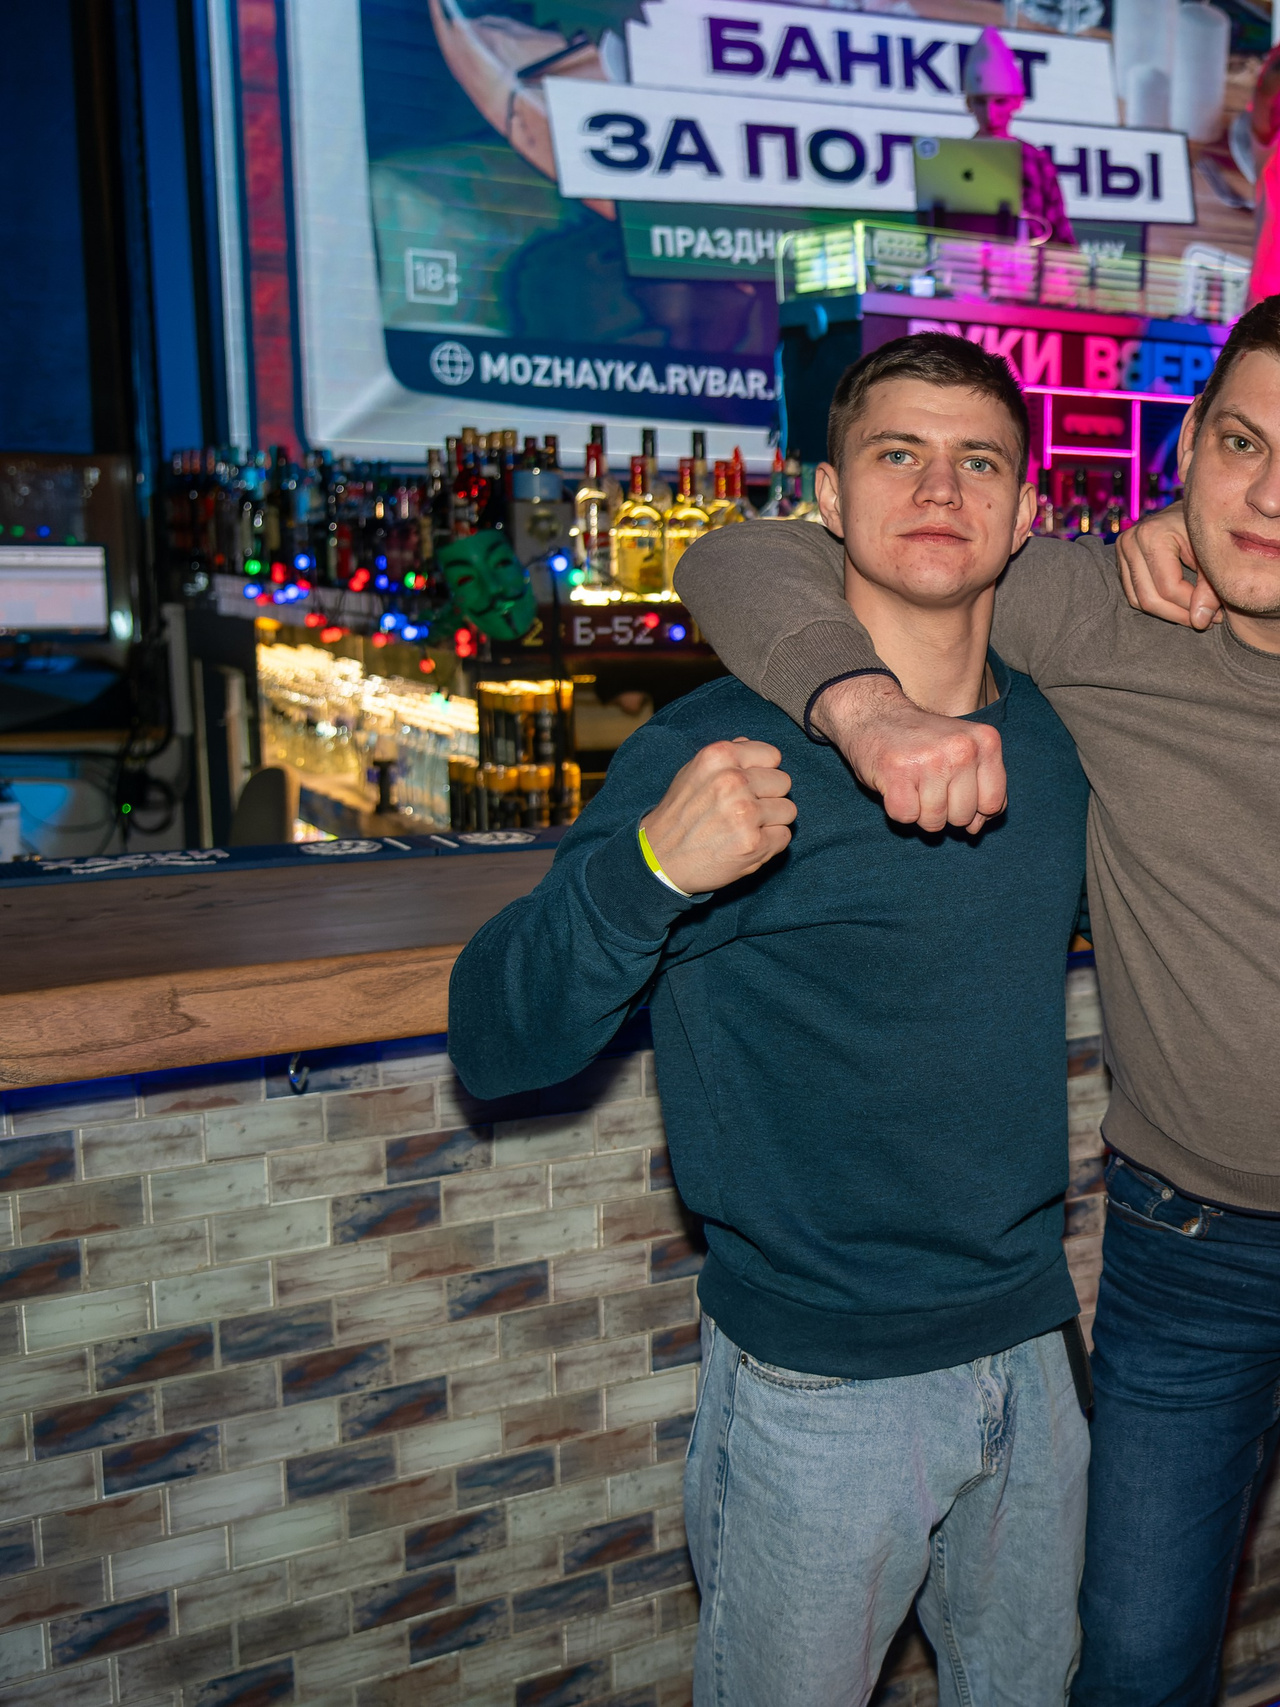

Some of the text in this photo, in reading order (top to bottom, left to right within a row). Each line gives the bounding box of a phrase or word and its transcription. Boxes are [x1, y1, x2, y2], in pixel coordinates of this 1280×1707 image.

[706, 17, 1049, 99] БАНКТ
[586, 113, 1161, 201] ЗА ПОЛНЫ
[415, 260, 462, 292] 18+
[479, 350, 783, 402] MOZHAYKA.RVBAR.
[907, 319, 1221, 396] КИ ВВЕР
[573, 616, 655, 647] Б-52
